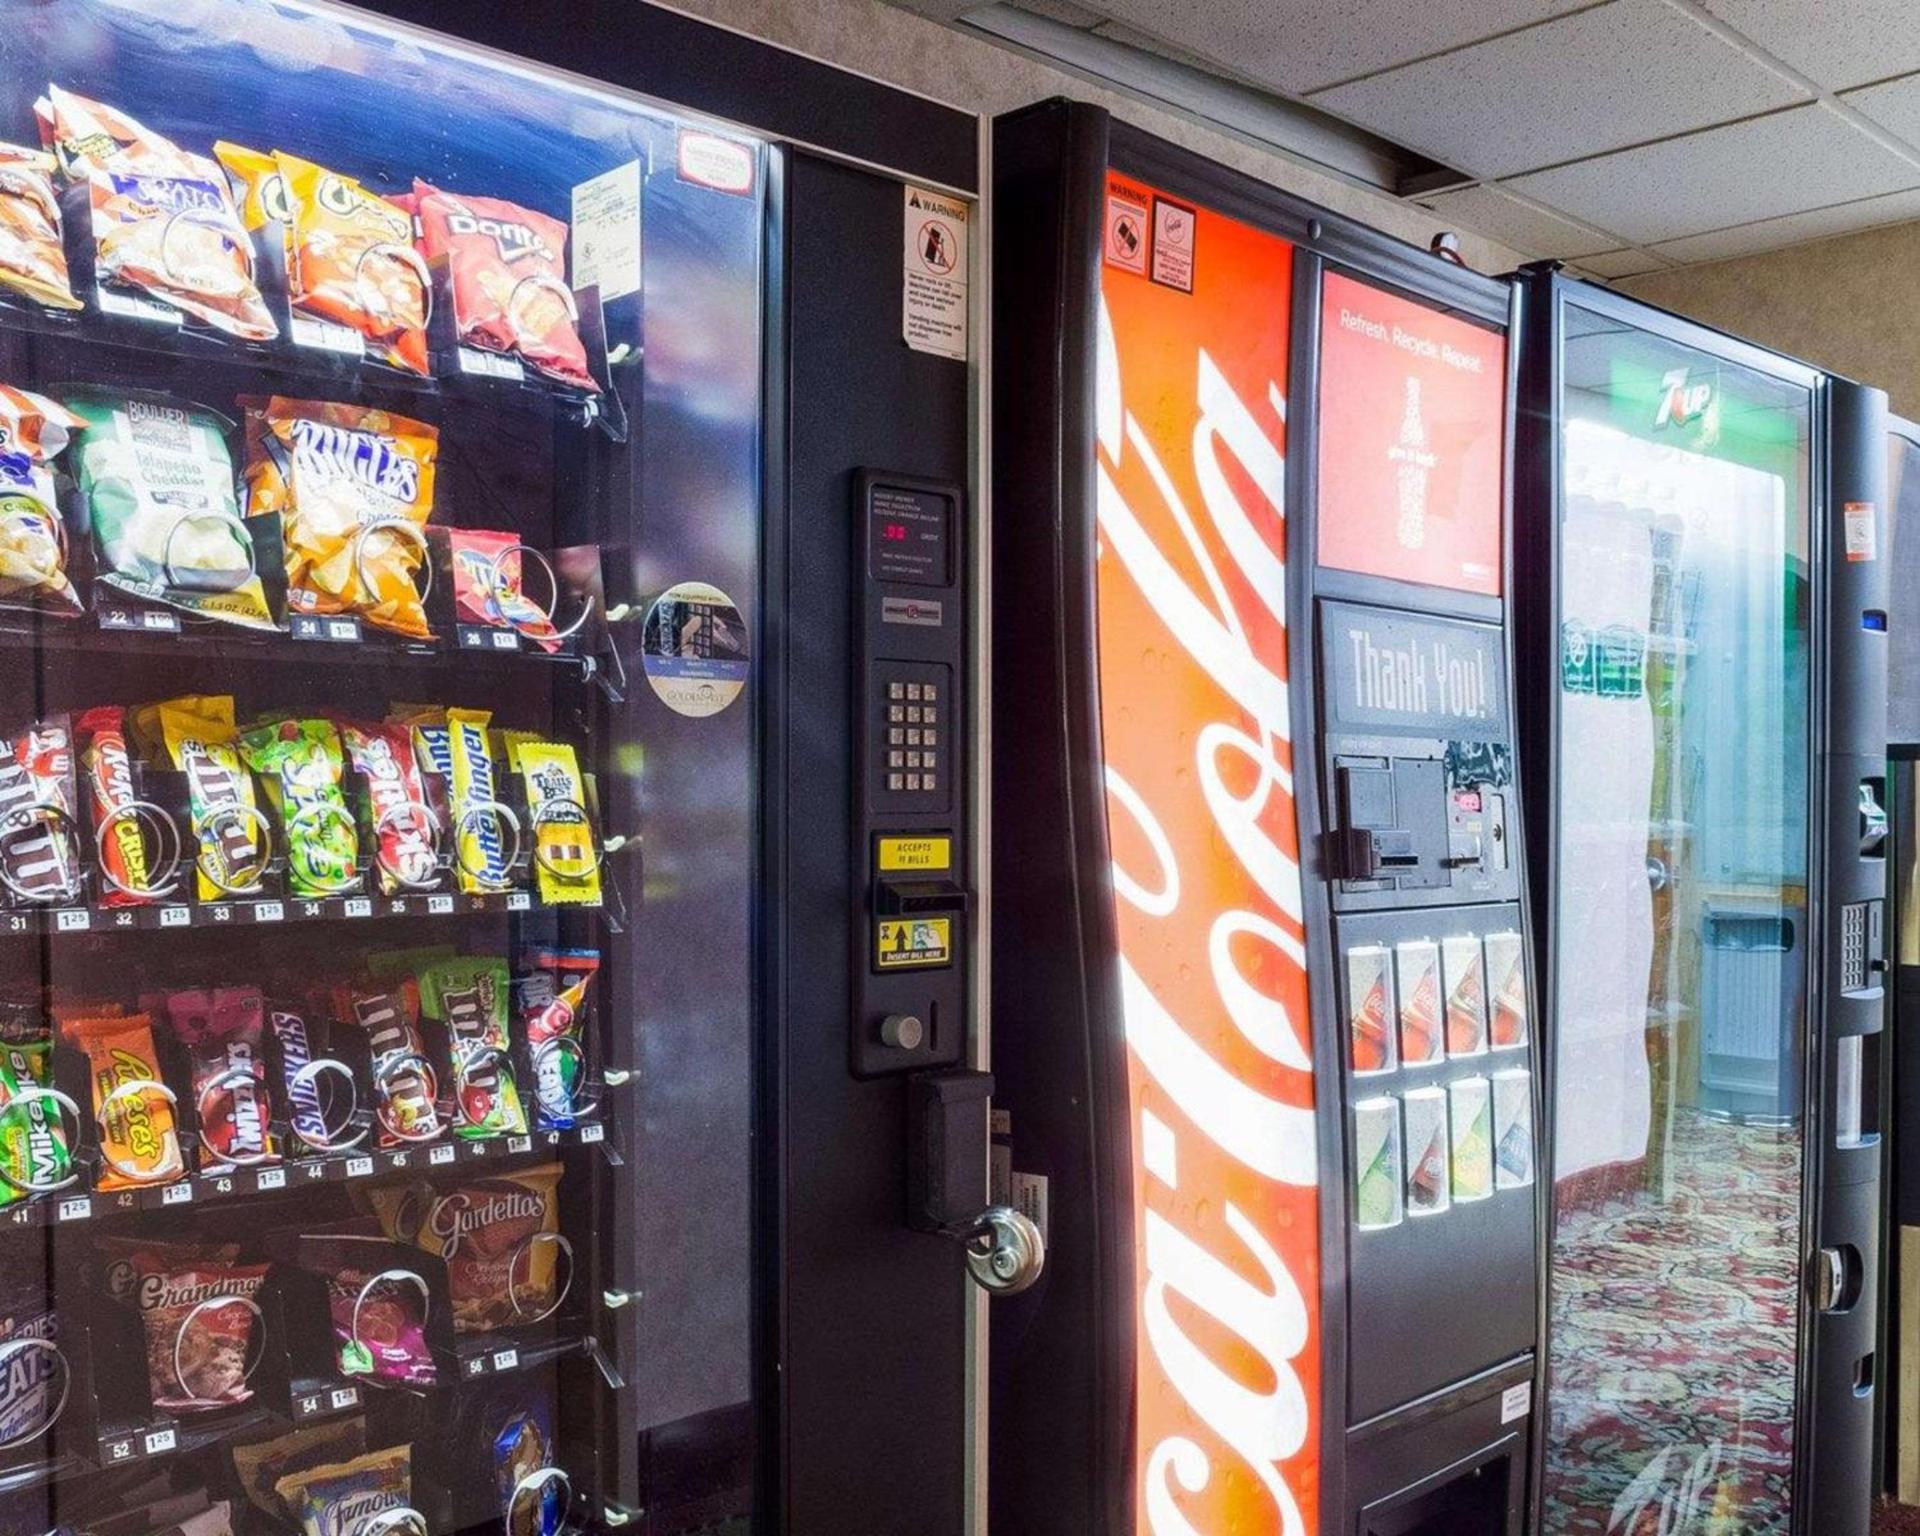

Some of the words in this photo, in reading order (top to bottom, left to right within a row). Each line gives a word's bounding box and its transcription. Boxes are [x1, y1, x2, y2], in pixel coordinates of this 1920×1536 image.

[1109, 182, 1148, 204] WARNING
[923, 199, 966, 222] WARNING
[1340, 308, 1389, 342] Refresh.
[127, 401, 185, 424] BOULDER
[110, 611, 128, 623] 22
[302, 620, 316, 634] 24
[1349, 630, 1428, 713] Thank
[1433, 641, 1486, 719] You!
[461, 724, 503, 886] Butterfinger
[896, 843, 932, 852] ACCEPTS
[907, 855, 930, 864] BILLS
[305, 904, 320, 916] 34
[392, 901, 406, 913] 35
[116, 912, 133, 925] 32
[214, 908, 230, 921] 33
[10, 916, 27, 930] 31
[886, 950, 910, 961] INSERT
[911, 950, 924, 960] BILL
[924, 949, 941, 959] HERE
[30, 1098, 55, 1186] Mike
[548, 1133, 560, 1144] 47
[472, 1145, 485, 1155] 46
[392, 1155, 406, 1167] 45
[308, 1166, 322, 1178] 44
[216, 1180, 232, 1192] 43
[117, 1194, 133, 1207] 42
[12, 1210, 28, 1223] 41
[303, 1400, 317, 1413] 54
[113, 1443, 129, 1458] 52
